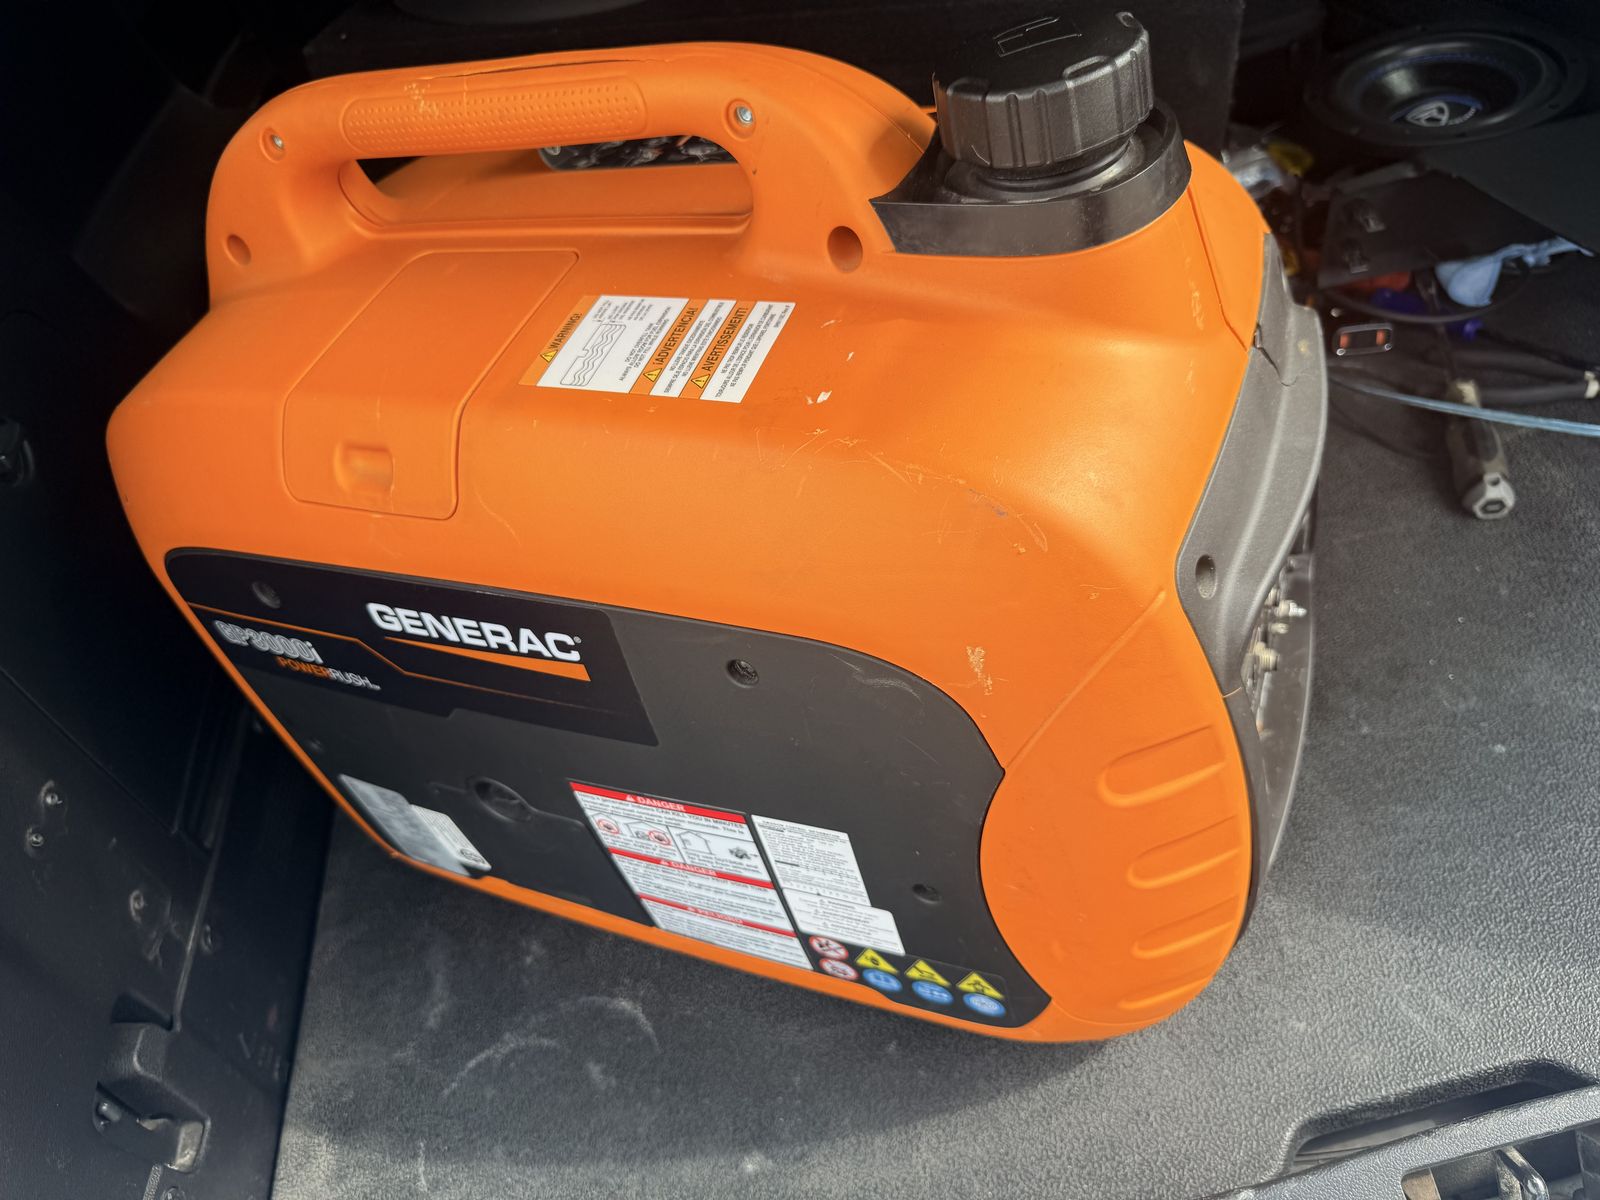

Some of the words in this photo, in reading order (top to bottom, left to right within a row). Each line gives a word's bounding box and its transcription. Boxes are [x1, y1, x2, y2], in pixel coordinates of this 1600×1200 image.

[548, 312, 583, 349] WARNING!
[699, 307, 748, 371] AVERTISSEMENT!
[213, 619, 324, 665] GP3000i
[636, 795, 685, 812] DANGER
